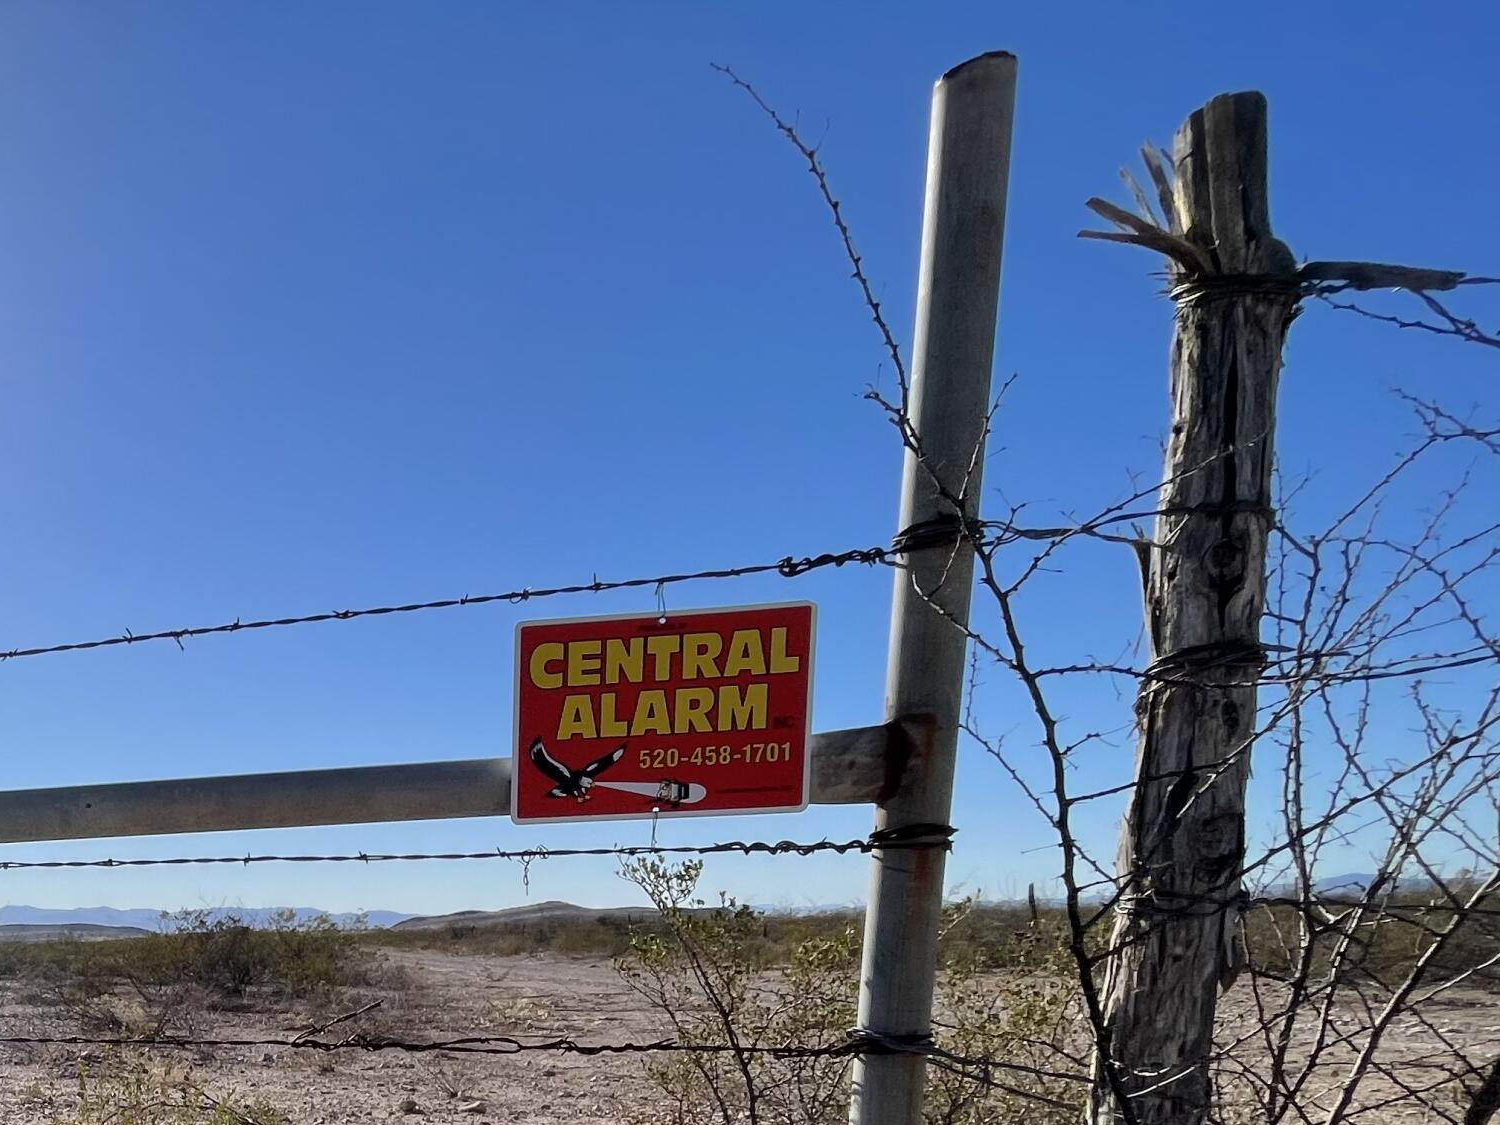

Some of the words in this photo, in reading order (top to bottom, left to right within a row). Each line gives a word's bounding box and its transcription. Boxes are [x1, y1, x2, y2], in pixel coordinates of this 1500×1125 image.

[529, 627, 800, 689] CENTRAL
[556, 683, 768, 741] ALARM
[639, 742, 791, 769] 520-458-1701
